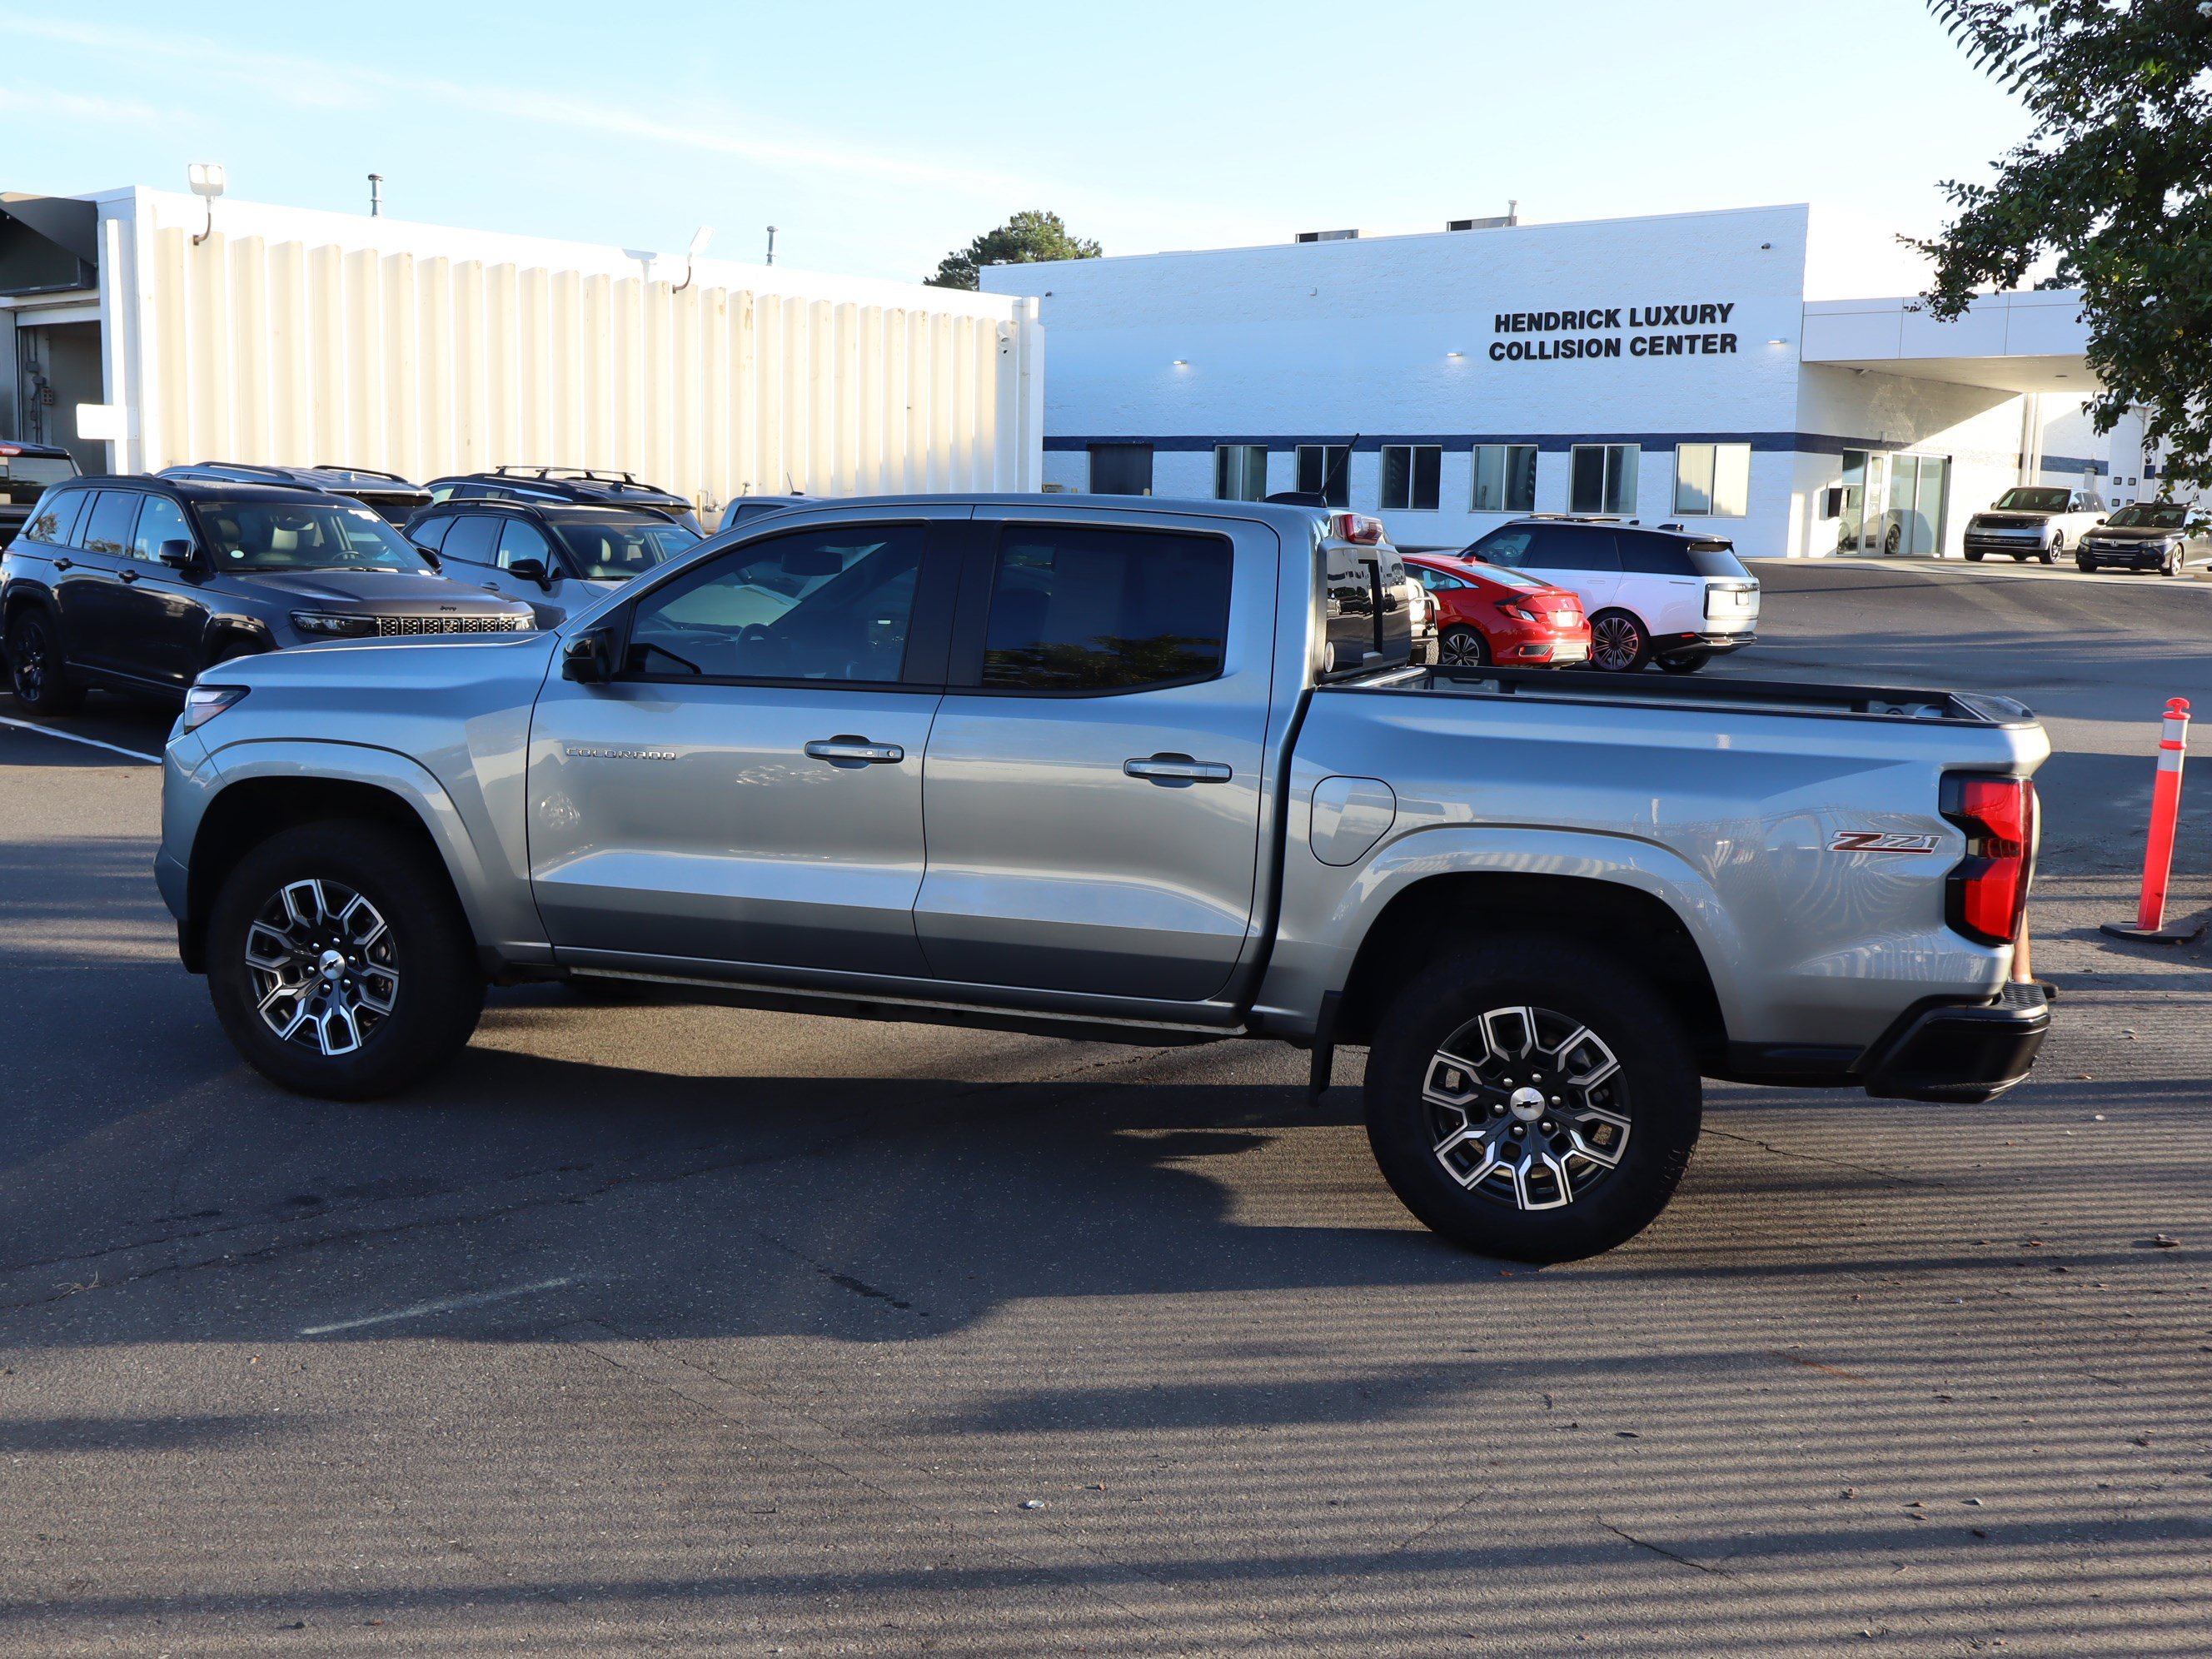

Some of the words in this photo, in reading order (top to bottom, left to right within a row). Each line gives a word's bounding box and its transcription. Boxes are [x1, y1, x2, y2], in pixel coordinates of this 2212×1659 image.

[1495, 309, 1621, 332] HENDRICK
[1629, 303, 1734, 326] LUXURY
[1489, 338, 1621, 361] COLLISION
[1629, 333, 1737, 356] CENTER
[566, 748, 675, 760] COLORADO
[1826, 830, 1942, 854] Z71
